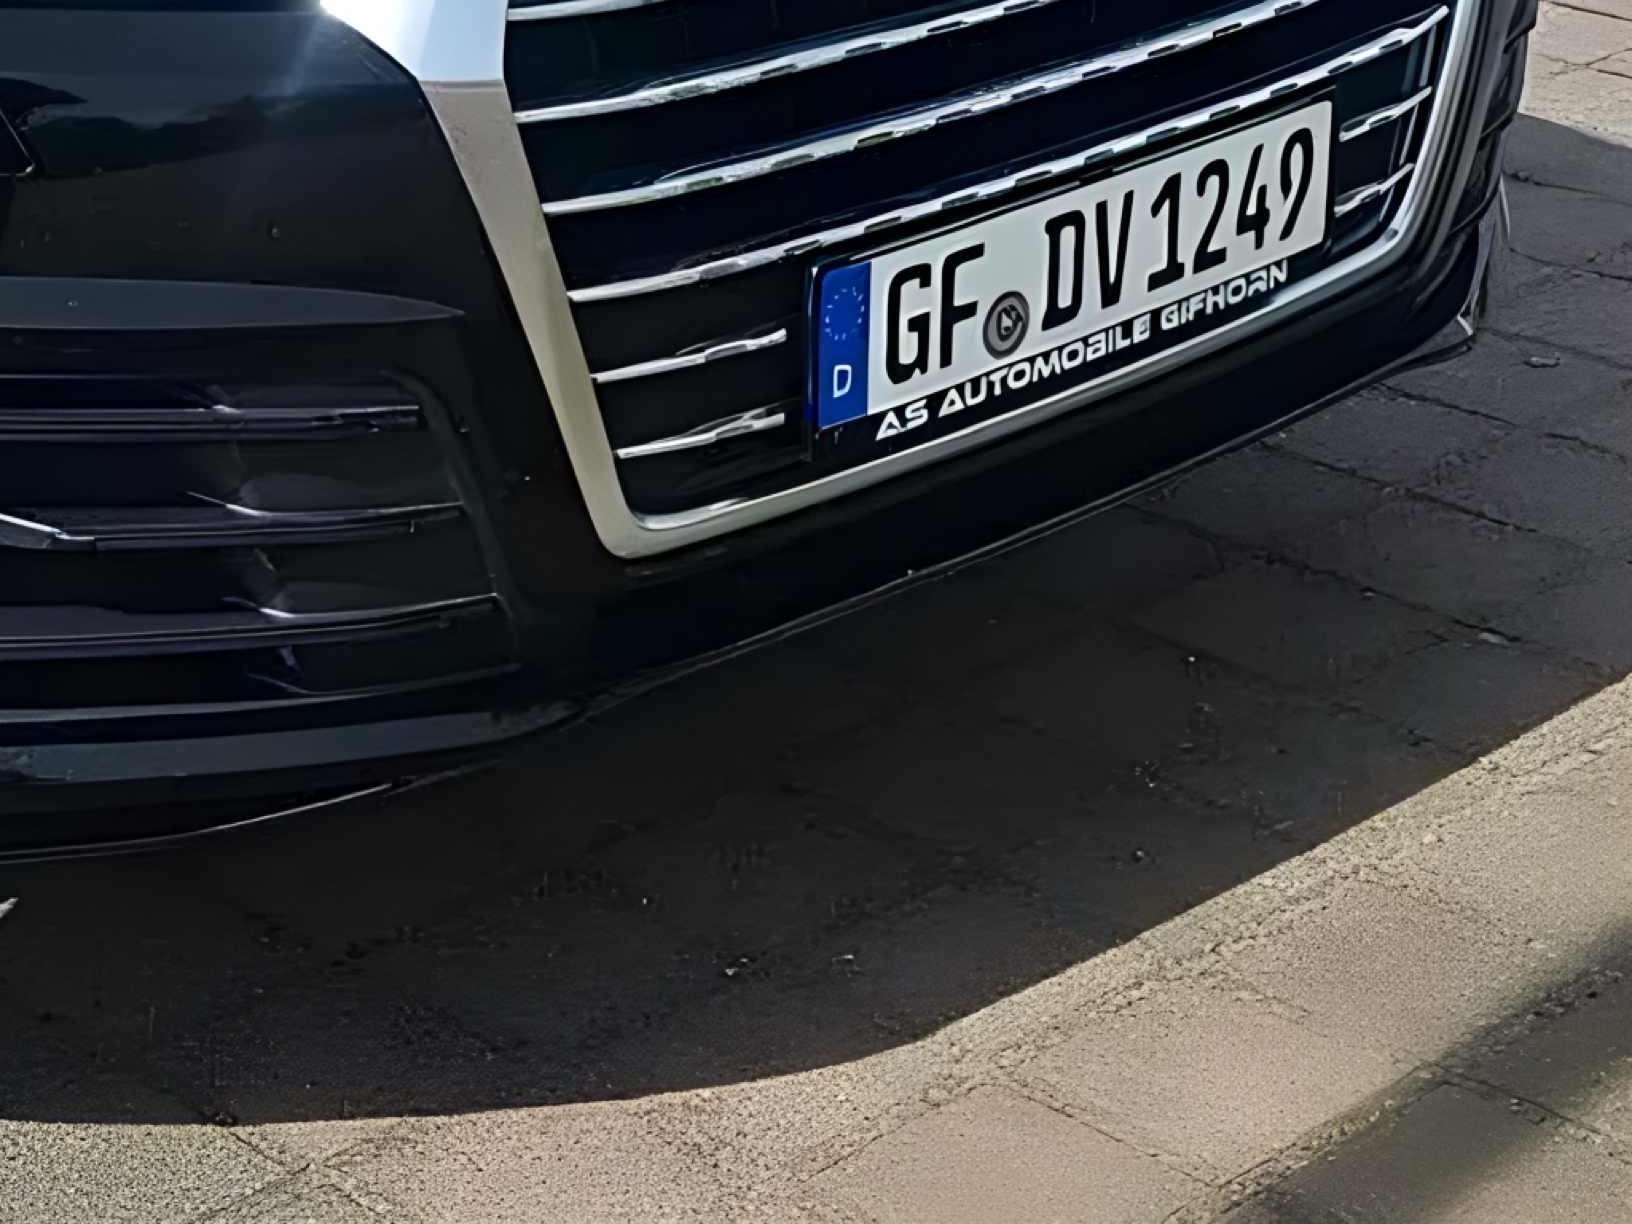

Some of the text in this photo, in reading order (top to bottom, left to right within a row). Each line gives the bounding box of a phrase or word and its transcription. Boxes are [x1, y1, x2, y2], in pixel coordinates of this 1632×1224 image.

[832, 364, 852, 398] D
[875, 259, 1289, 442] AS AUTOMOBILE GIFHORN
[886, 243, 985, 385] GF
